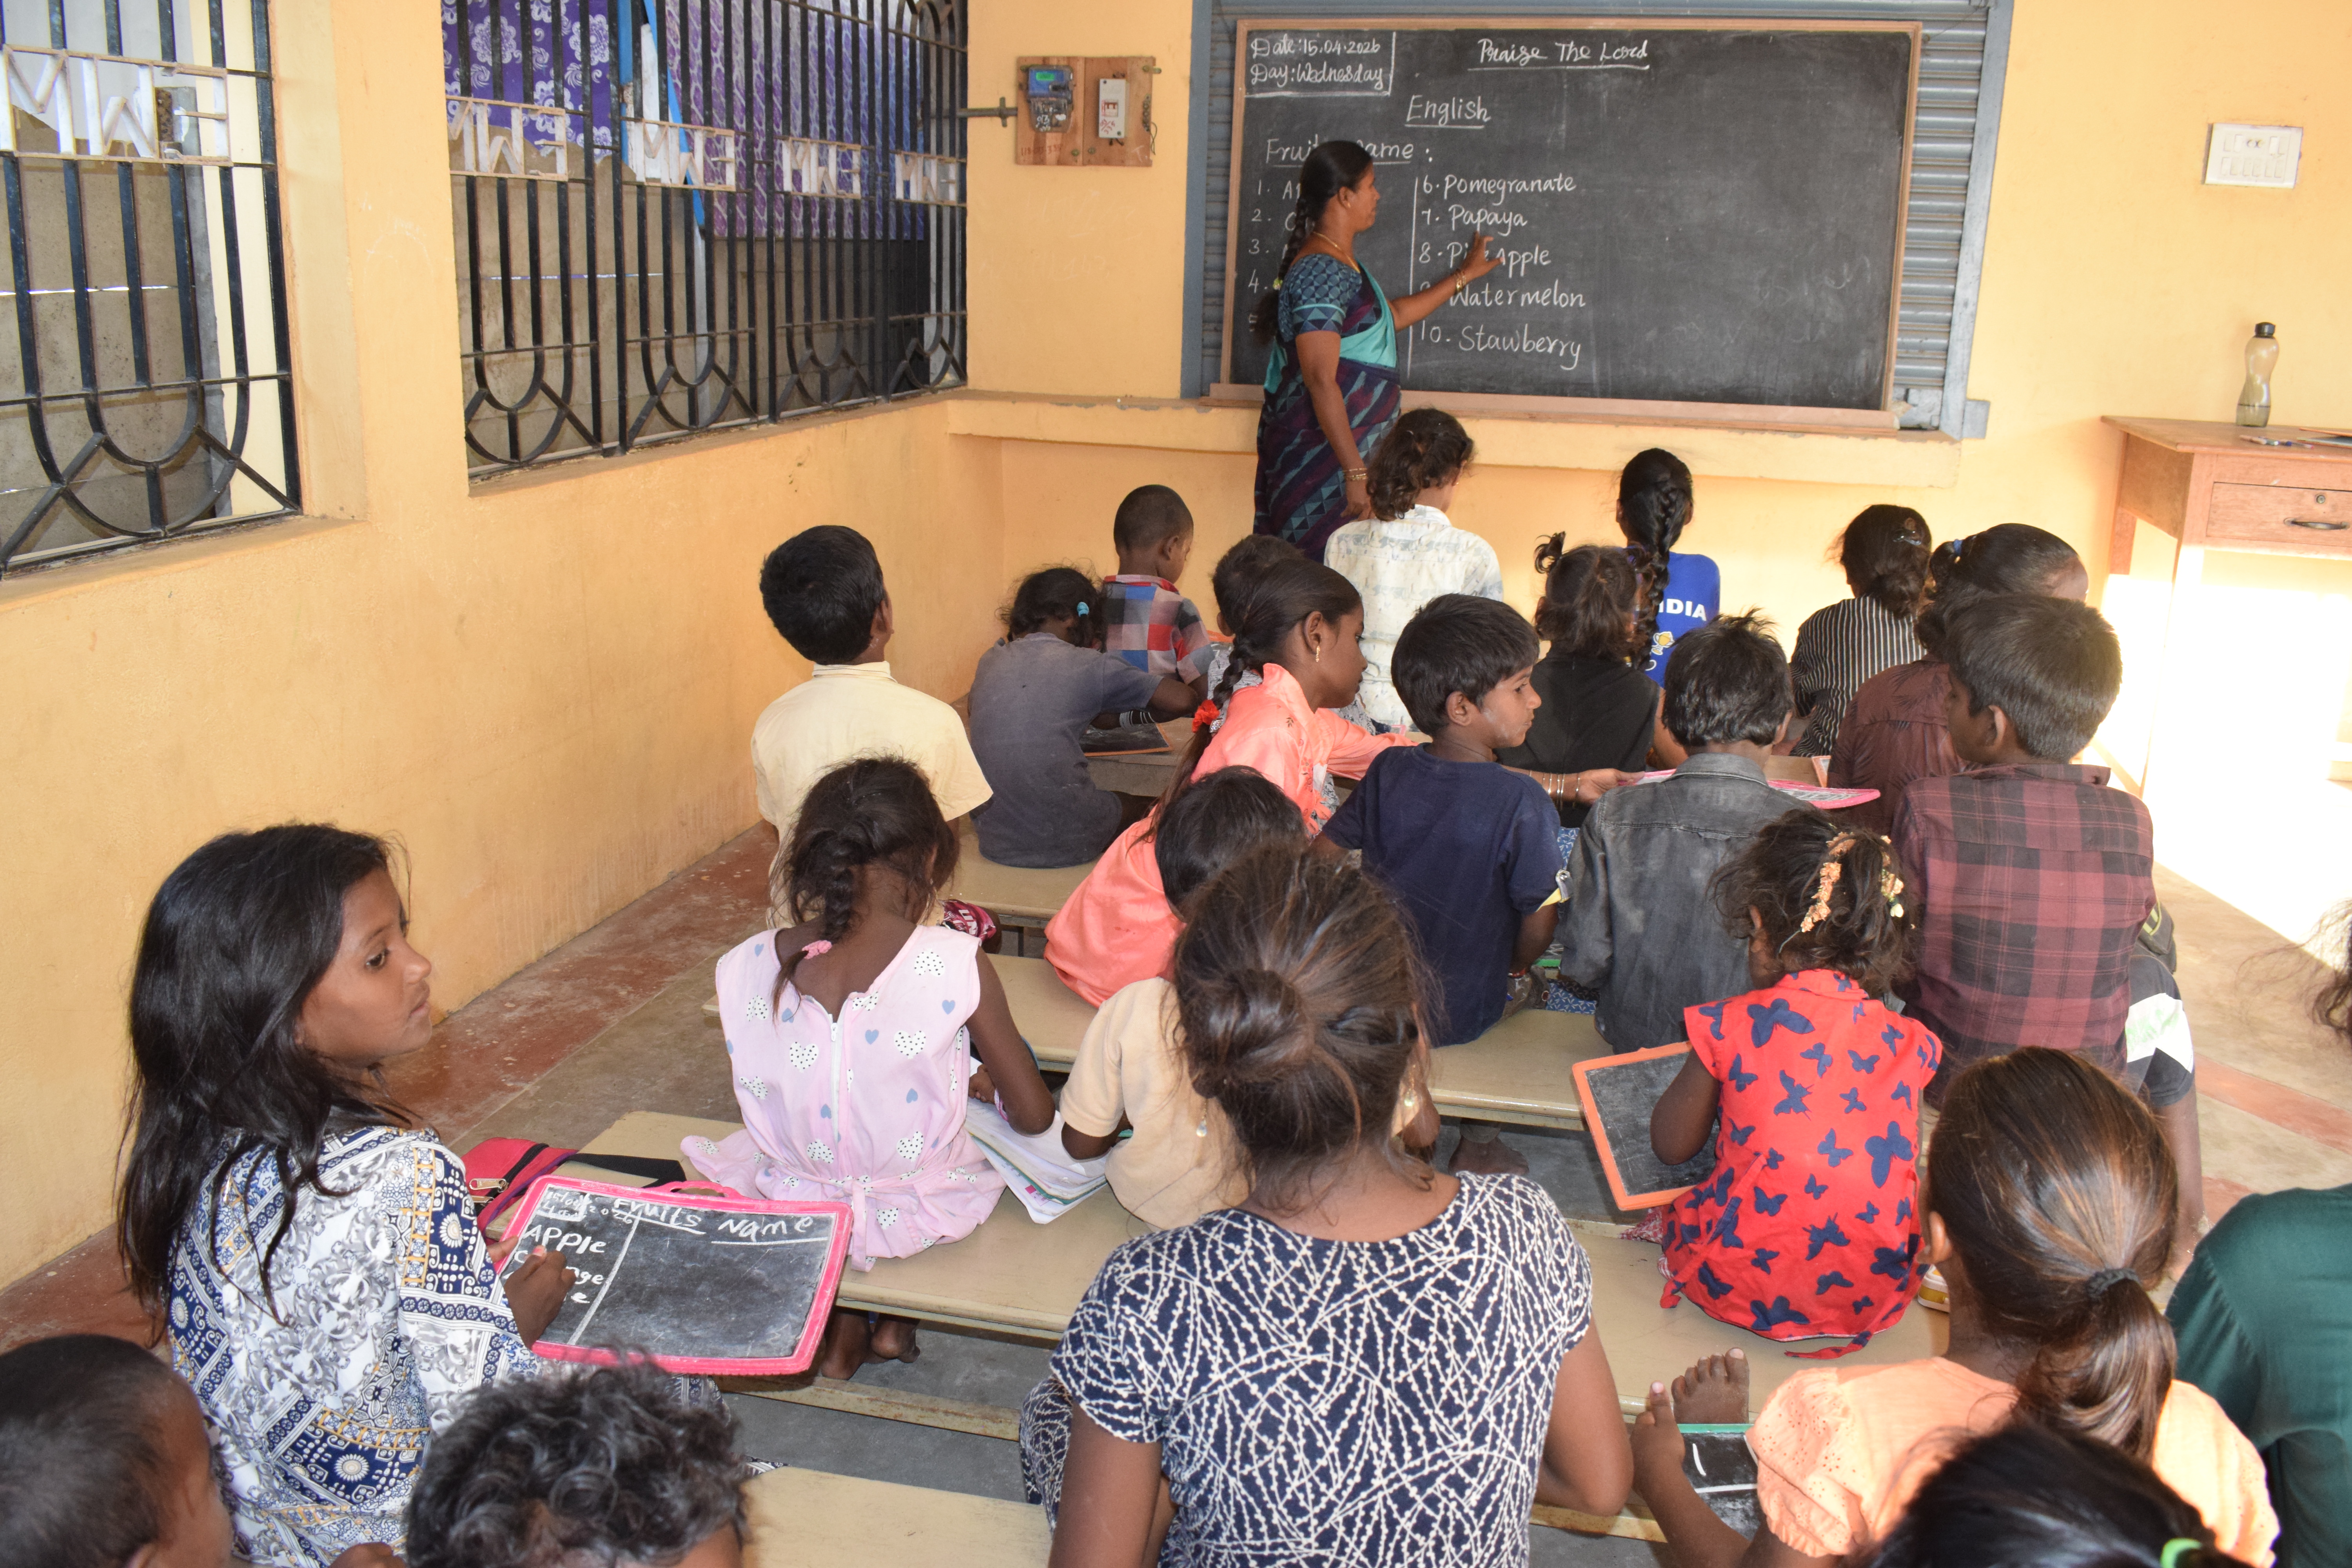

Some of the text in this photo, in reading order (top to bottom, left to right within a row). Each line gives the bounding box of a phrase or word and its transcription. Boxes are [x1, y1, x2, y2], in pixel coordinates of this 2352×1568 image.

[1478, 38, 1548, 66] Praise
[1555, 40, 1592, 62] The
[1406, 95, 1491, 126] English
[1444, 172, 1577, 206] Pomegranate
[1448, 204, 1528, 237] Papaya
[1459, 323, 1581, 370] Stawberry
[1659, 598, 1707, 621] DIA
